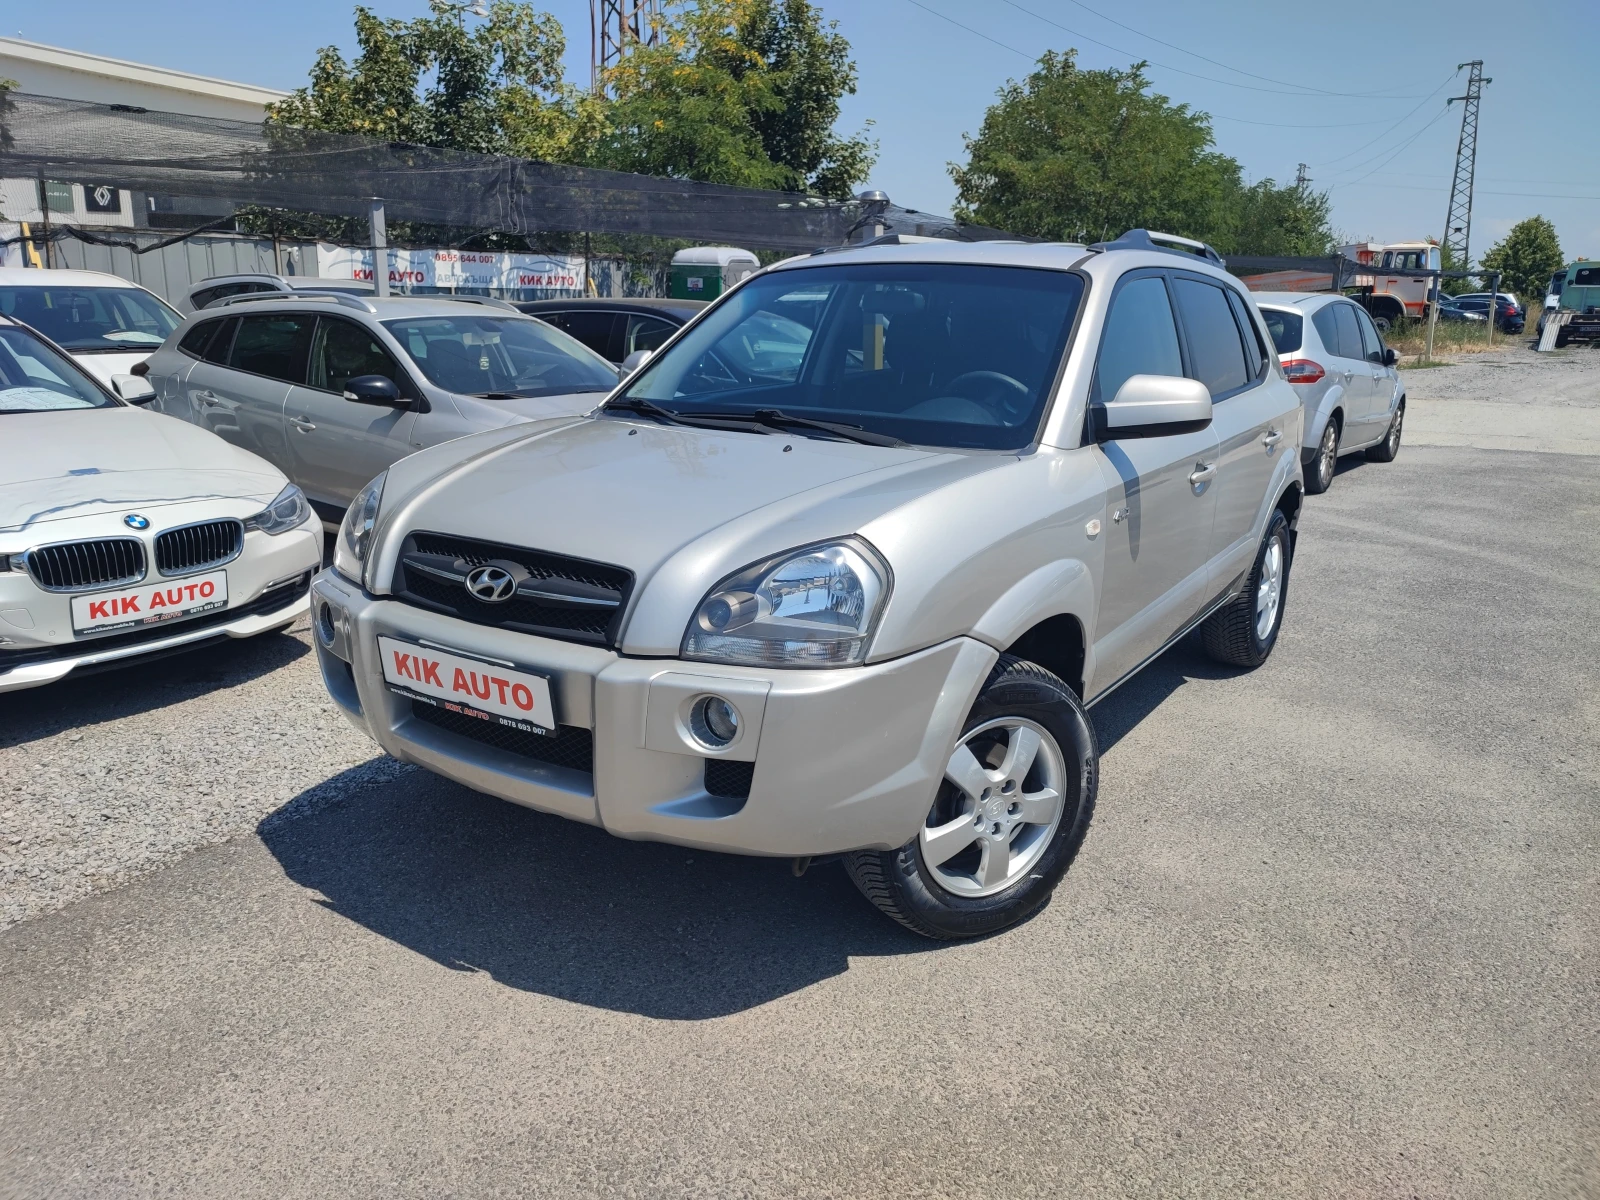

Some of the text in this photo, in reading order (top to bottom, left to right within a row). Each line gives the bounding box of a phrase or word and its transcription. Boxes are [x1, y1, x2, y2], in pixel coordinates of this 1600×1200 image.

[435, 253, 494, 264] 0895 644 007
[388, 271, 424, 282] АУТО
[519, 275, 575, 287] КИК АУТО
[89, 581, 215, 620] KIK AUTO
[393, 650, 534, 712] KIK AUTO
[499, 717, 516, 728] 0878
